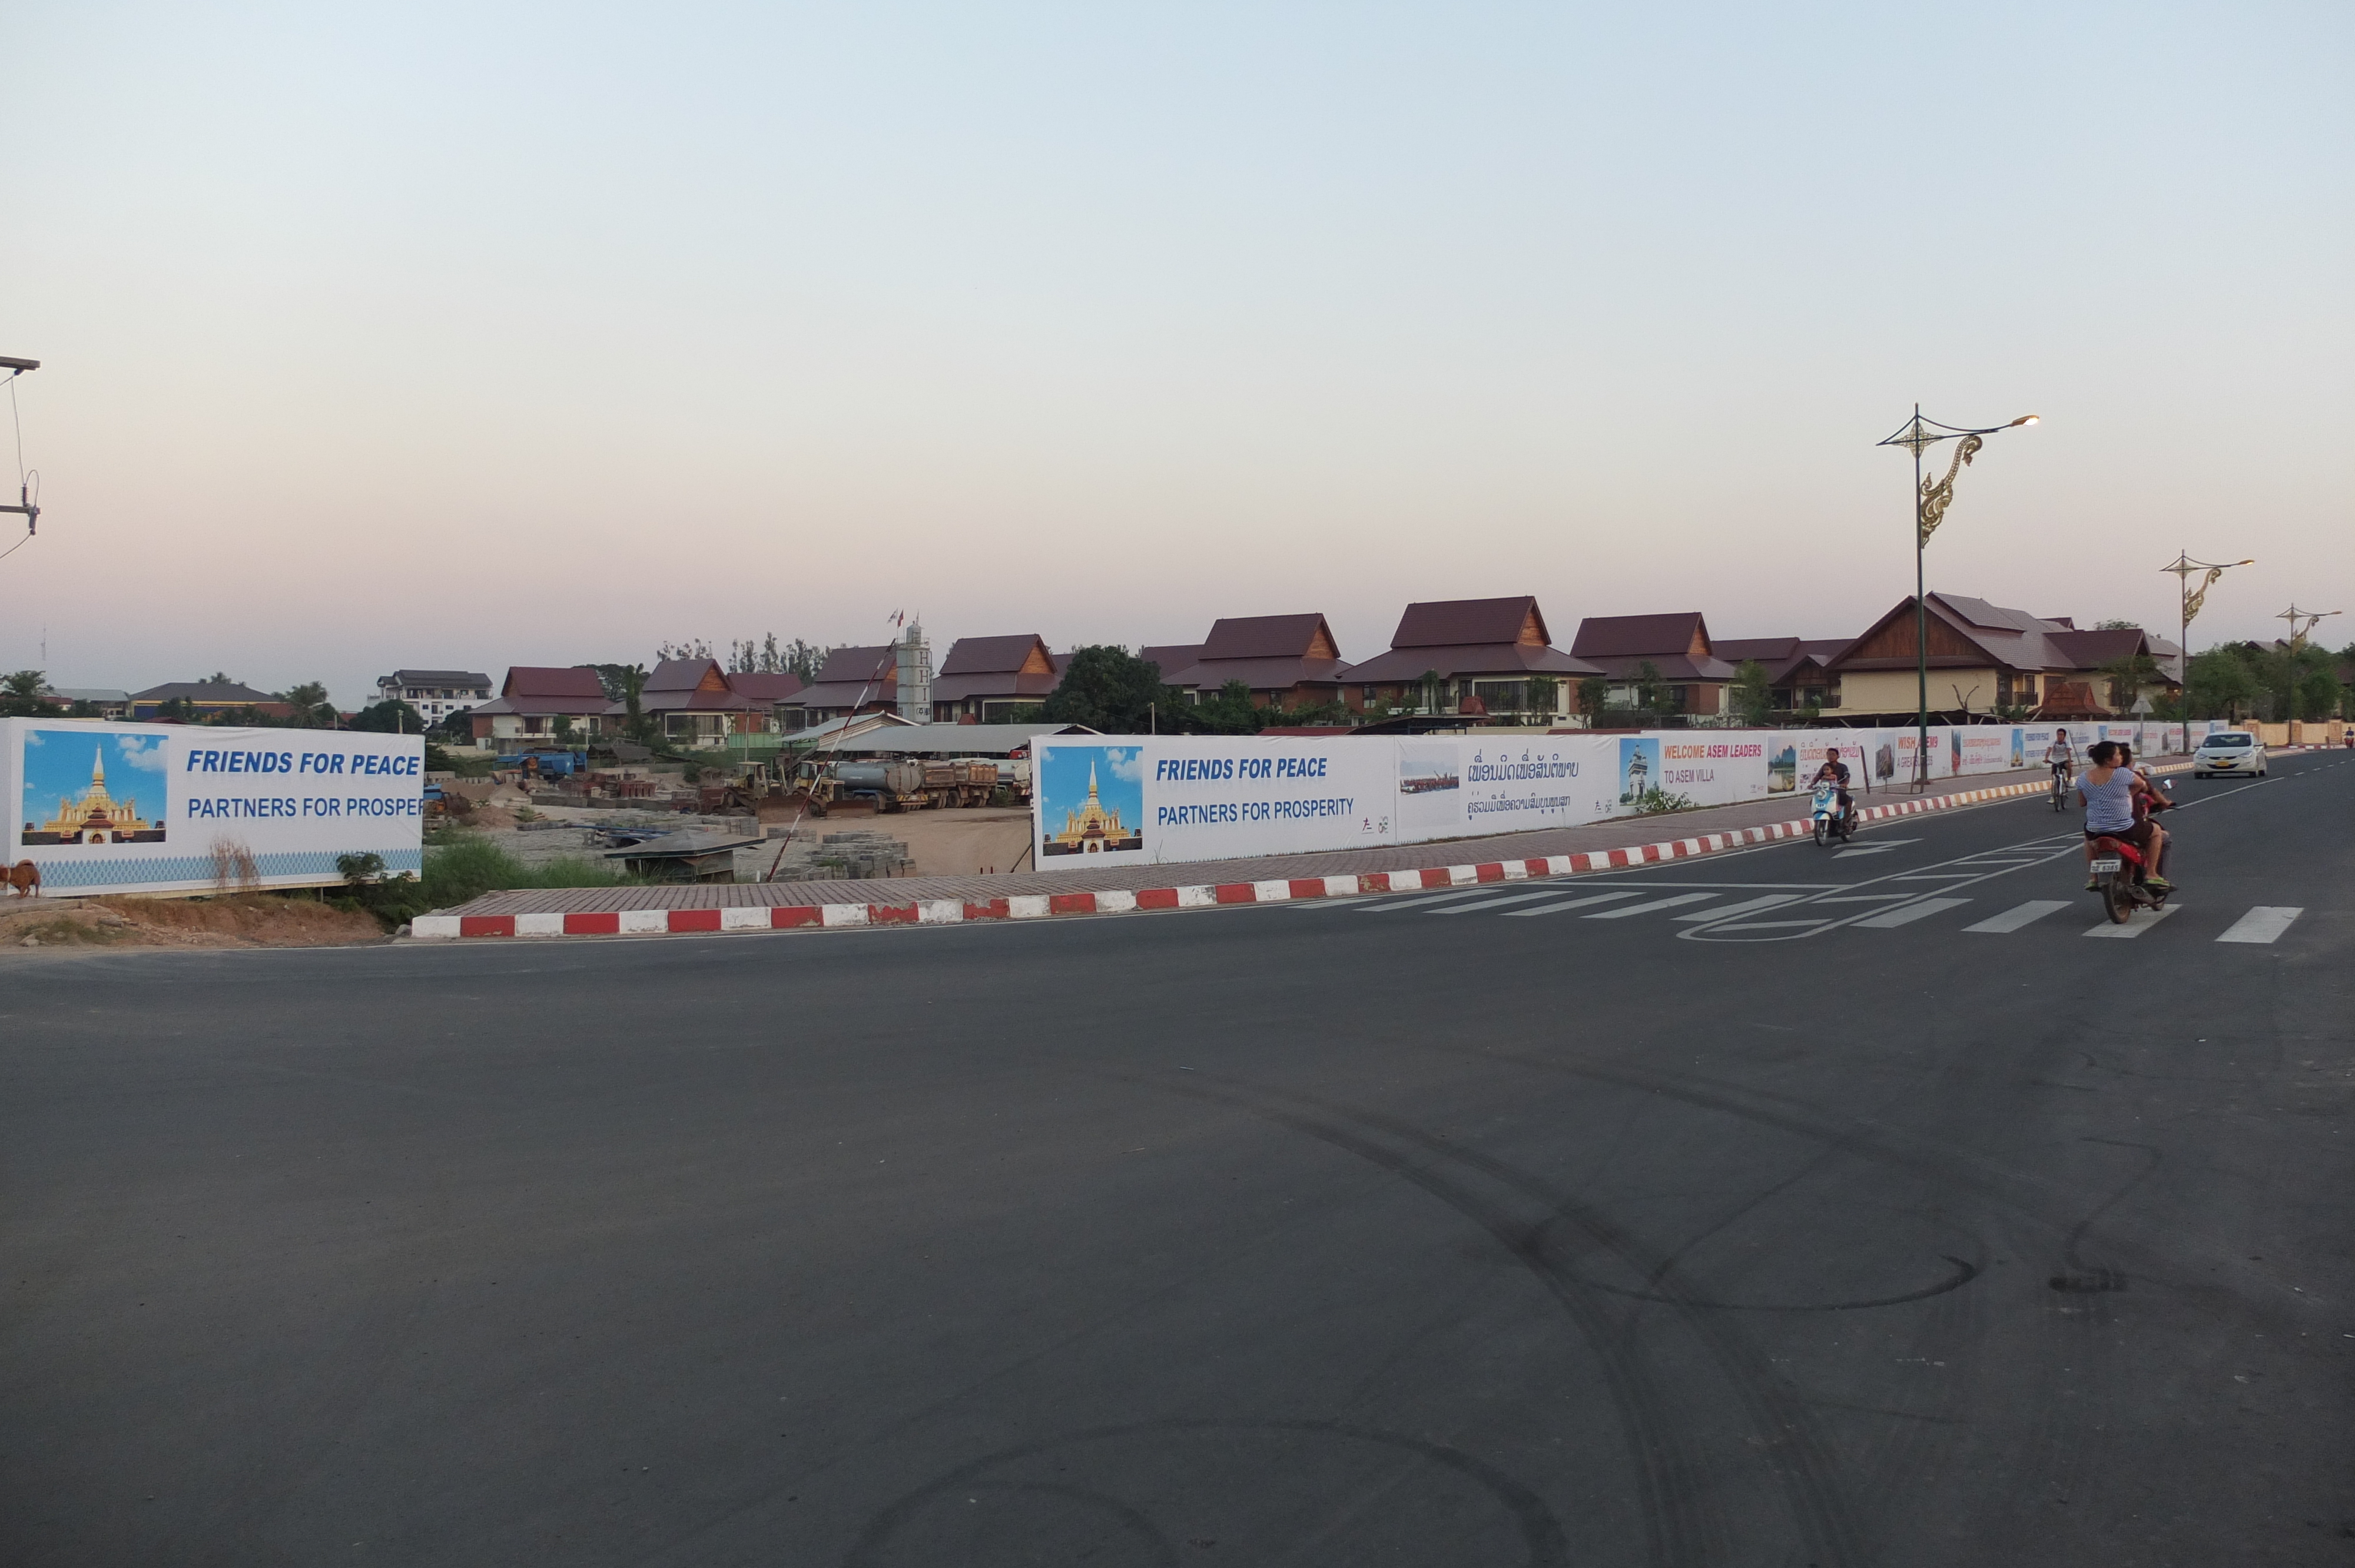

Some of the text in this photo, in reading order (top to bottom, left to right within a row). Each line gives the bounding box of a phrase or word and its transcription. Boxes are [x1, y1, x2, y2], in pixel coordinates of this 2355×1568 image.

[1664, 744, 1762, 759] WELCOME ASEM LEADERS
[1899, 736, 1916, 749] WISH
[187, 750, 420, 775] FRIENDS FOR PEACE
[1156, 758, 1327, 781] FRIENDS FOR PEACE
[1664, 769, 1714, 783] TO ASEM VILLA
[188, 798, 296, 818] PARTNERS
[303, 798, 341, 816] FOR
[1158, 798, 1354, 826] PARTNERS FOR PROSPERITY
